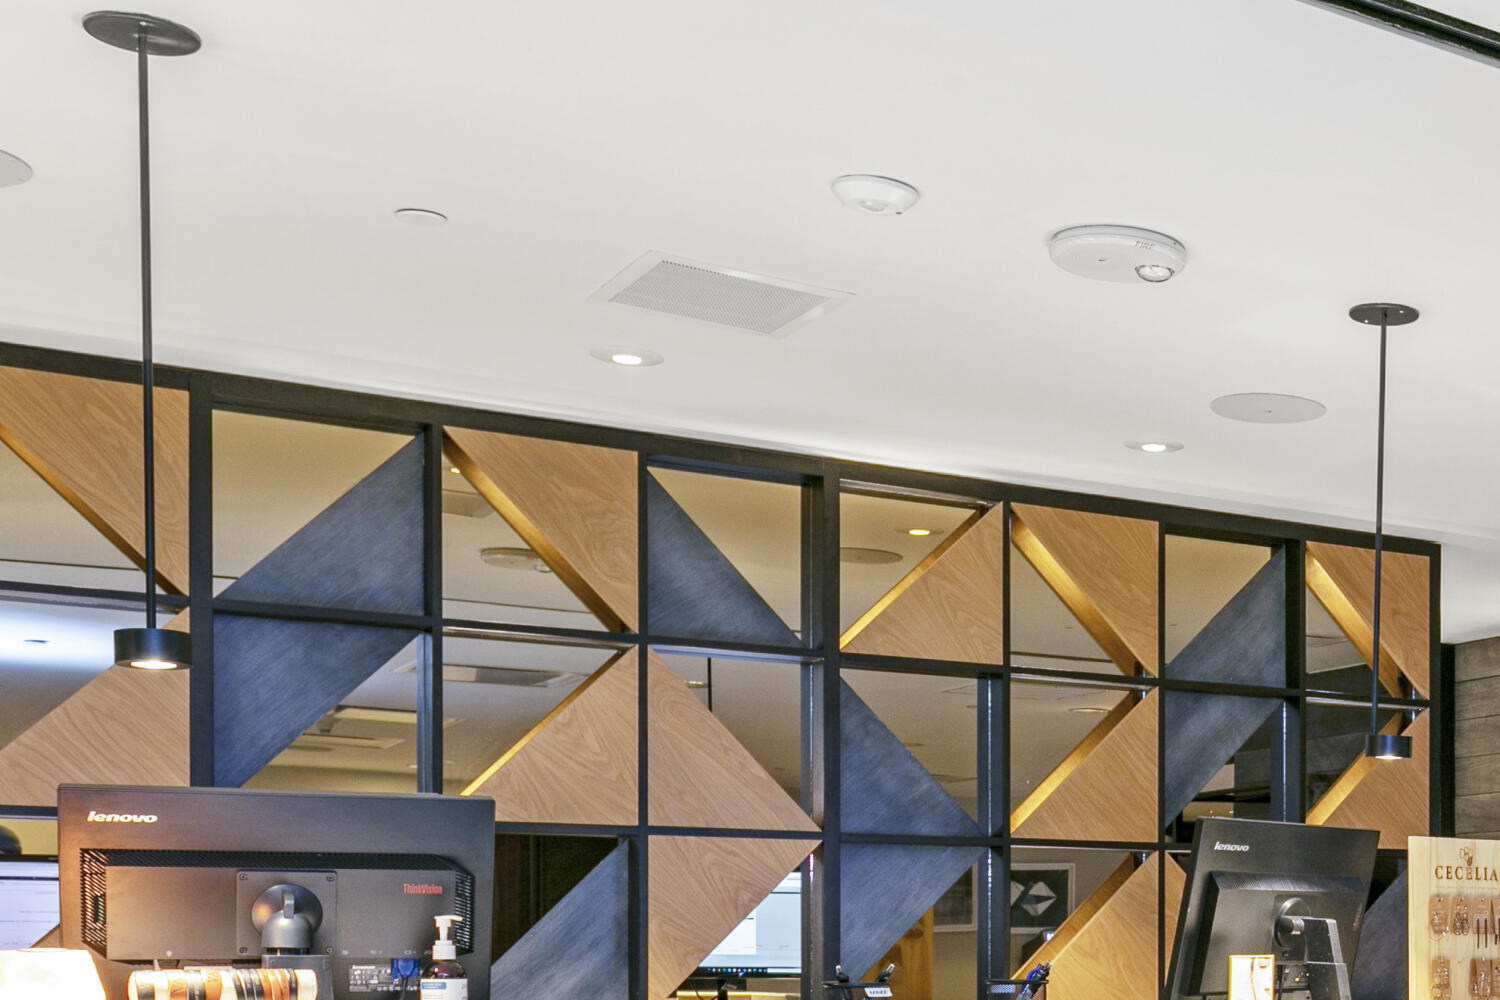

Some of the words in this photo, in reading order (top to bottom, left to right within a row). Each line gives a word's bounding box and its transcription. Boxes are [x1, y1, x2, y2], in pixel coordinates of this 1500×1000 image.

[87, 810, 158, 823] lenovo
[1213, 841, 1251, 852] lenovo
[1434, 865, 1499, 881] CECELIA
[403, 883, 443, 895] ThinkVision
